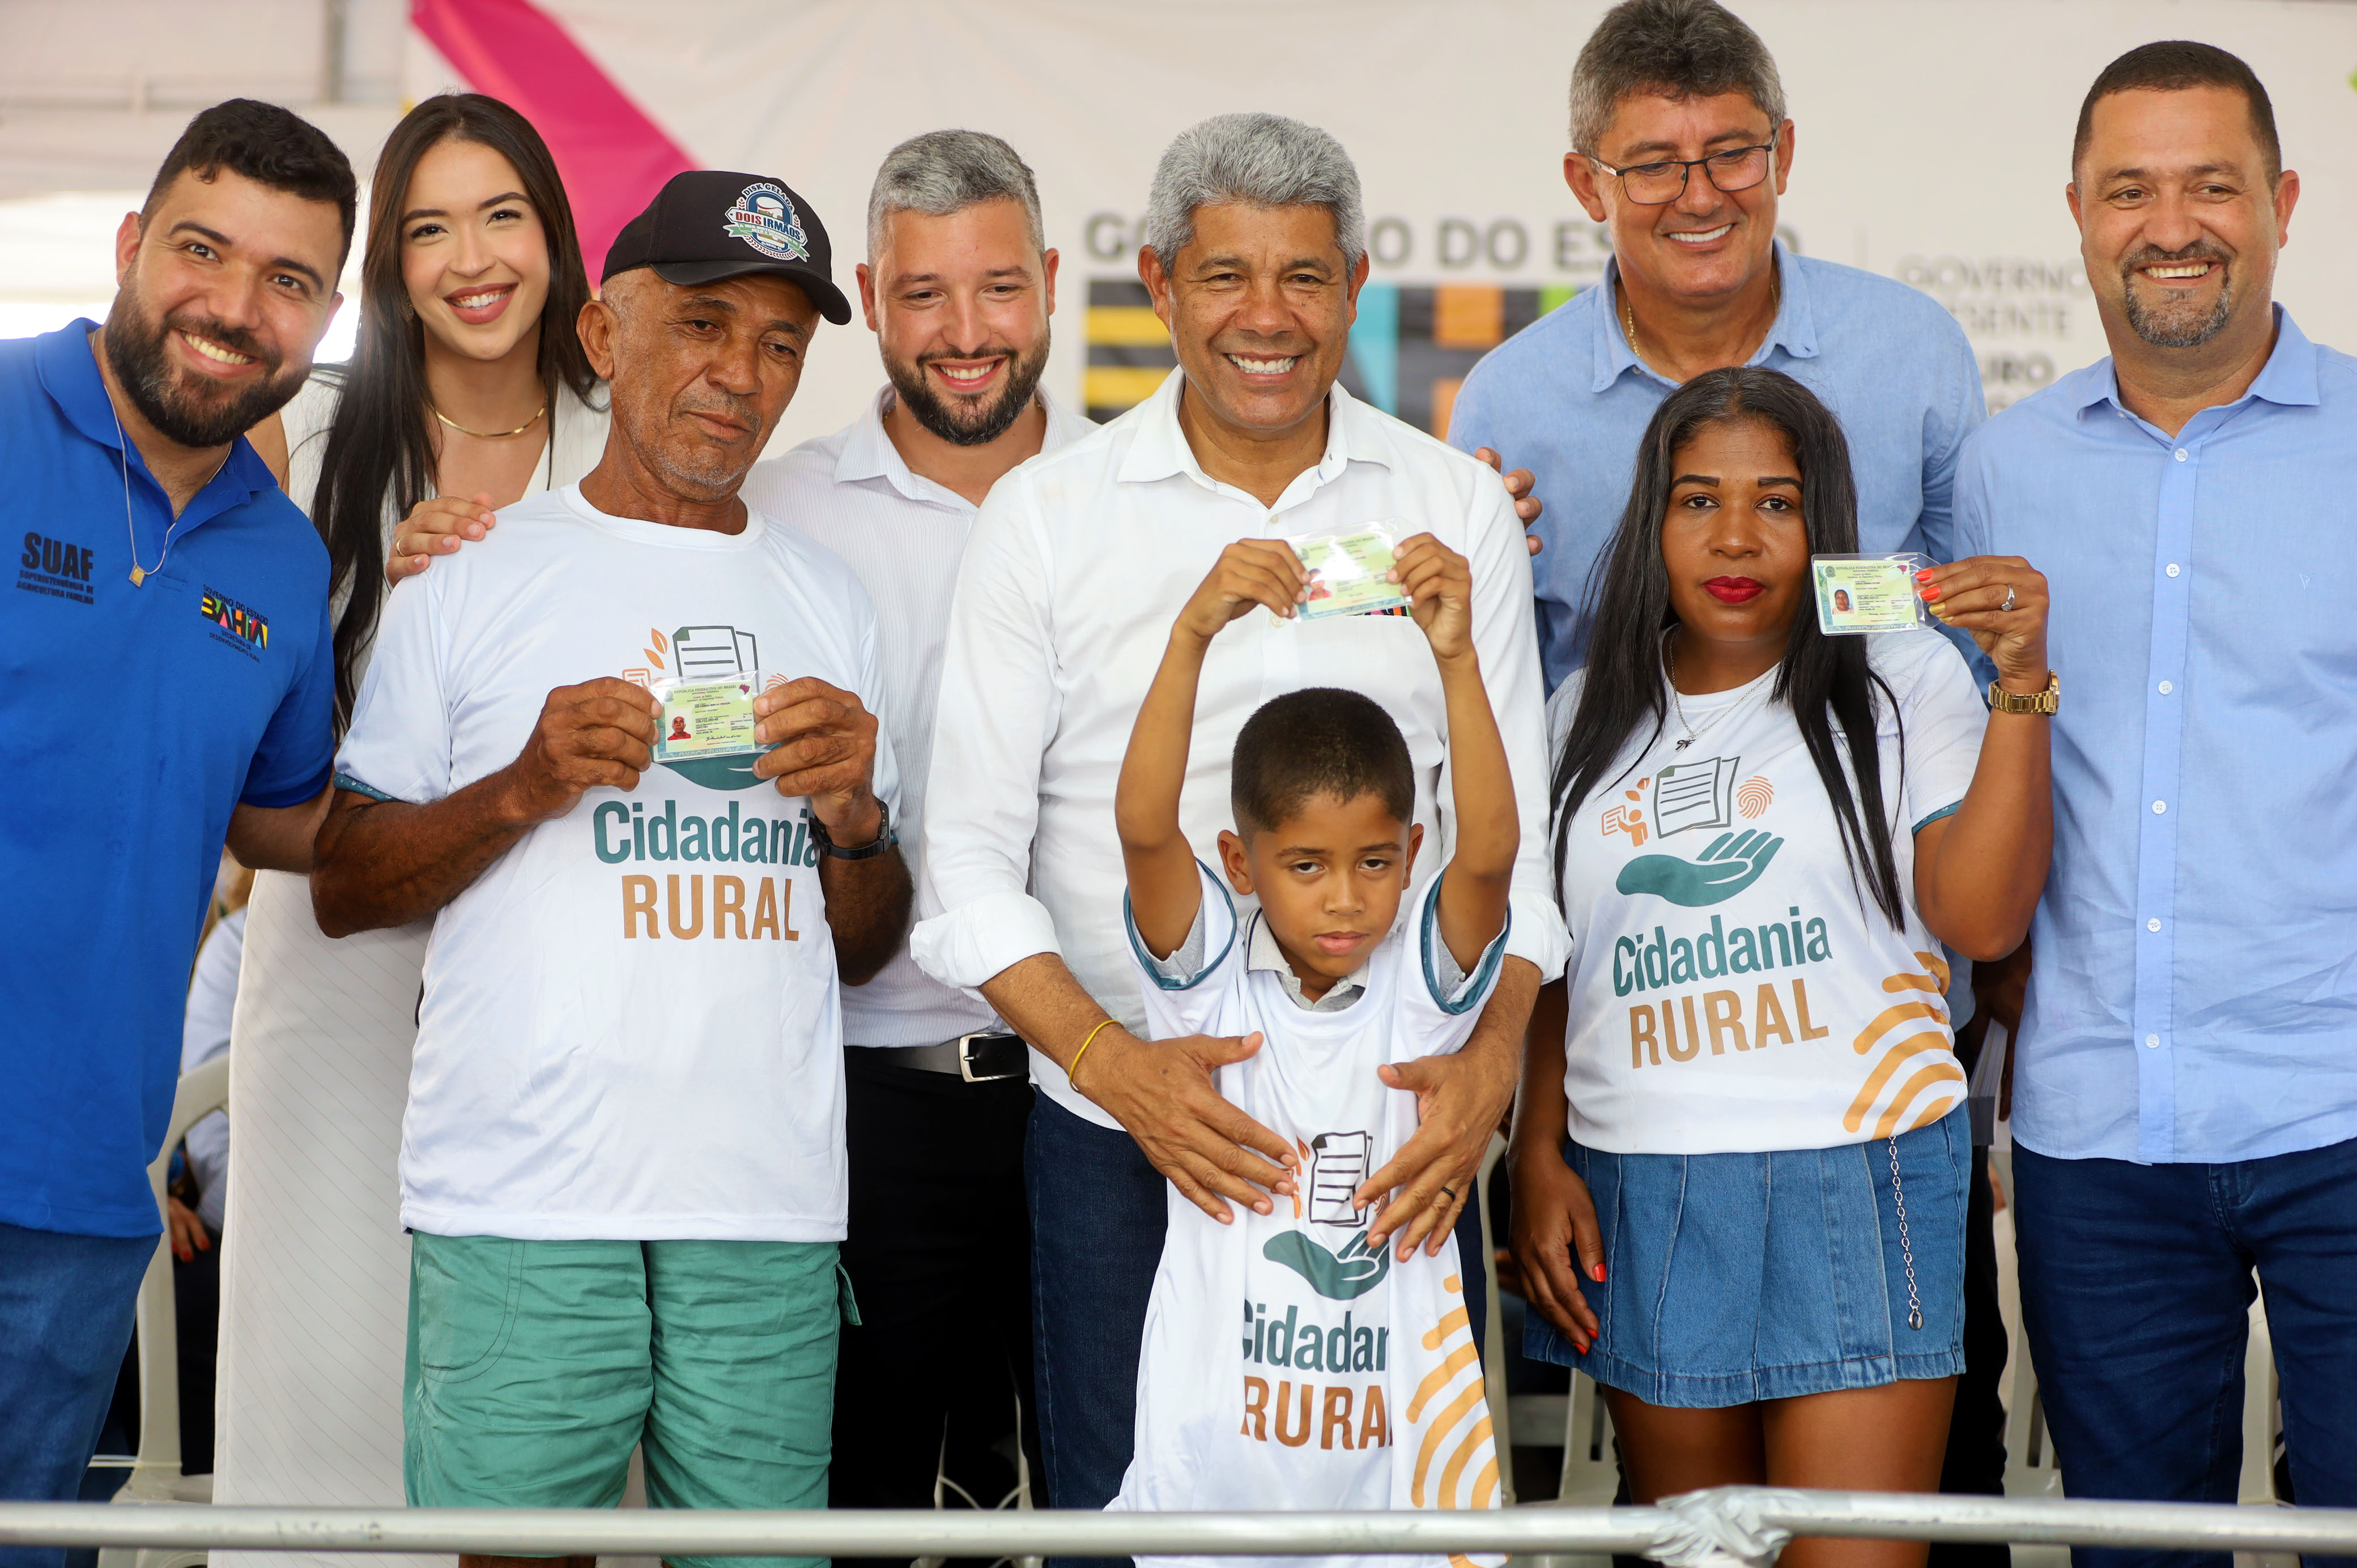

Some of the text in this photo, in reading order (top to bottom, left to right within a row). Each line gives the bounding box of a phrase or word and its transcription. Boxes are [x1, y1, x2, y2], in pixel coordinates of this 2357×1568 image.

[735, 211, 801, 241] DOIS IRMÃOS
[743, 184, 793, 212] DISK GELADA
[1437, 218, 1529, 270] DO
[21, 531, 94, 582] SUAF
[201, 592, 268, 651] BAHIA
[203, 583, 269, 626] GOVERNO DO ESTADO
[622, 874, 799, 941] RURAL
[1613, 906, 1833, 997] Cidadania
[1629, 978, 1830, 1069] RURAL
[1242, 1298, 1389, 1374] idada
[1240, 1375, 1393, 1451] RURA
